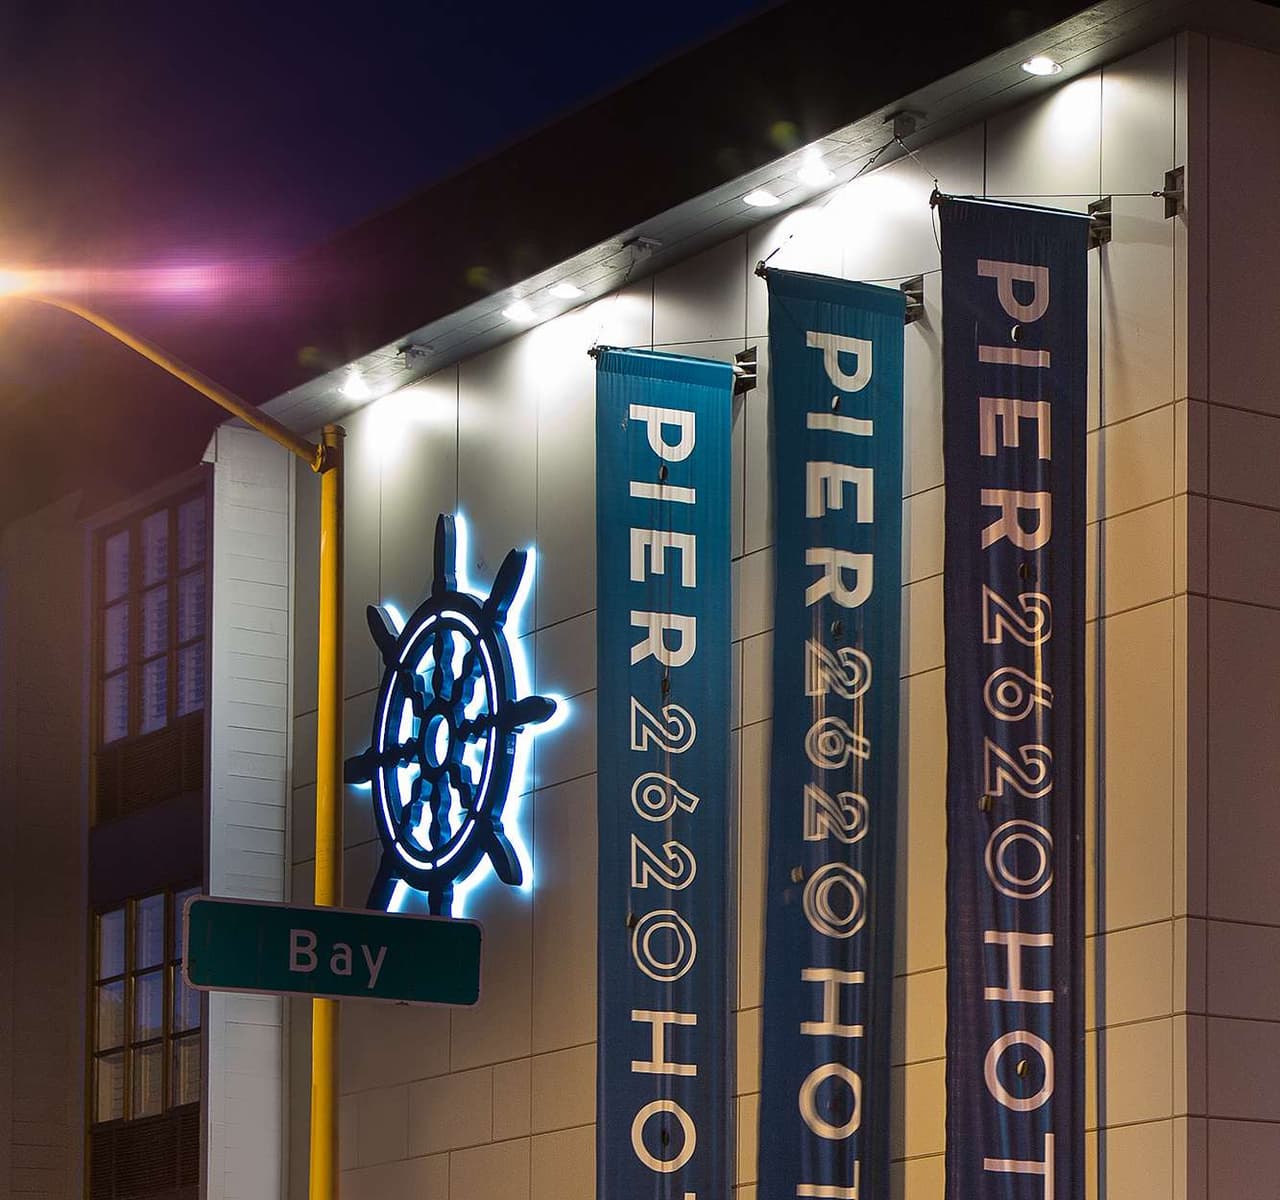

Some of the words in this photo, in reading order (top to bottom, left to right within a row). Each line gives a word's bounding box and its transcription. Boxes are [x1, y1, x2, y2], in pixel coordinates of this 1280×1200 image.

[629, 403, 698, 668] PIER
[805, 330, 874, 609] PIER
[977, 258, 1053, 550] PIER
[630, 694, 701, 982] 2620
[803, 638, 873, 939] 2620
[982, 584, 1055, 900] 2620
[288, 928, 388, 989] Bay
